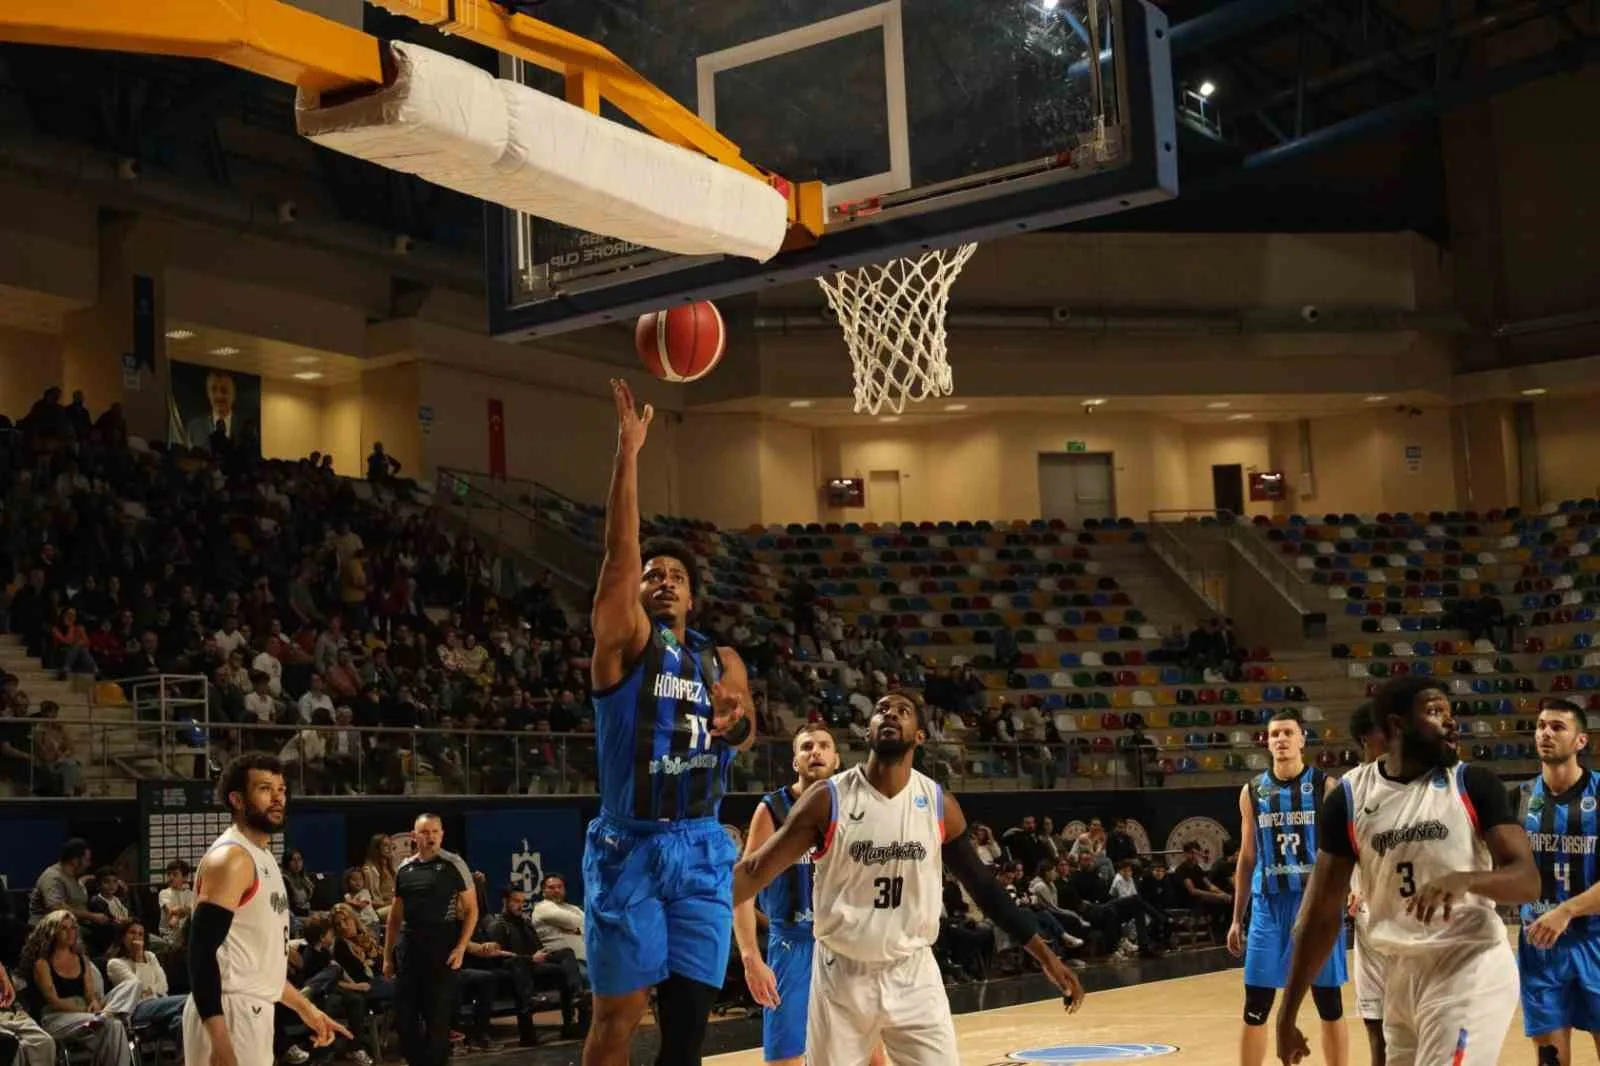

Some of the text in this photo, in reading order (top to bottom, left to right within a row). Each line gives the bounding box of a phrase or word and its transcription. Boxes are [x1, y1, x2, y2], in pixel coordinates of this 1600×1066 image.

[874, 876, 903, 909] 30
[1396, 861, 1416, 898] 3
[1554, 862, 1570, 892] 4
